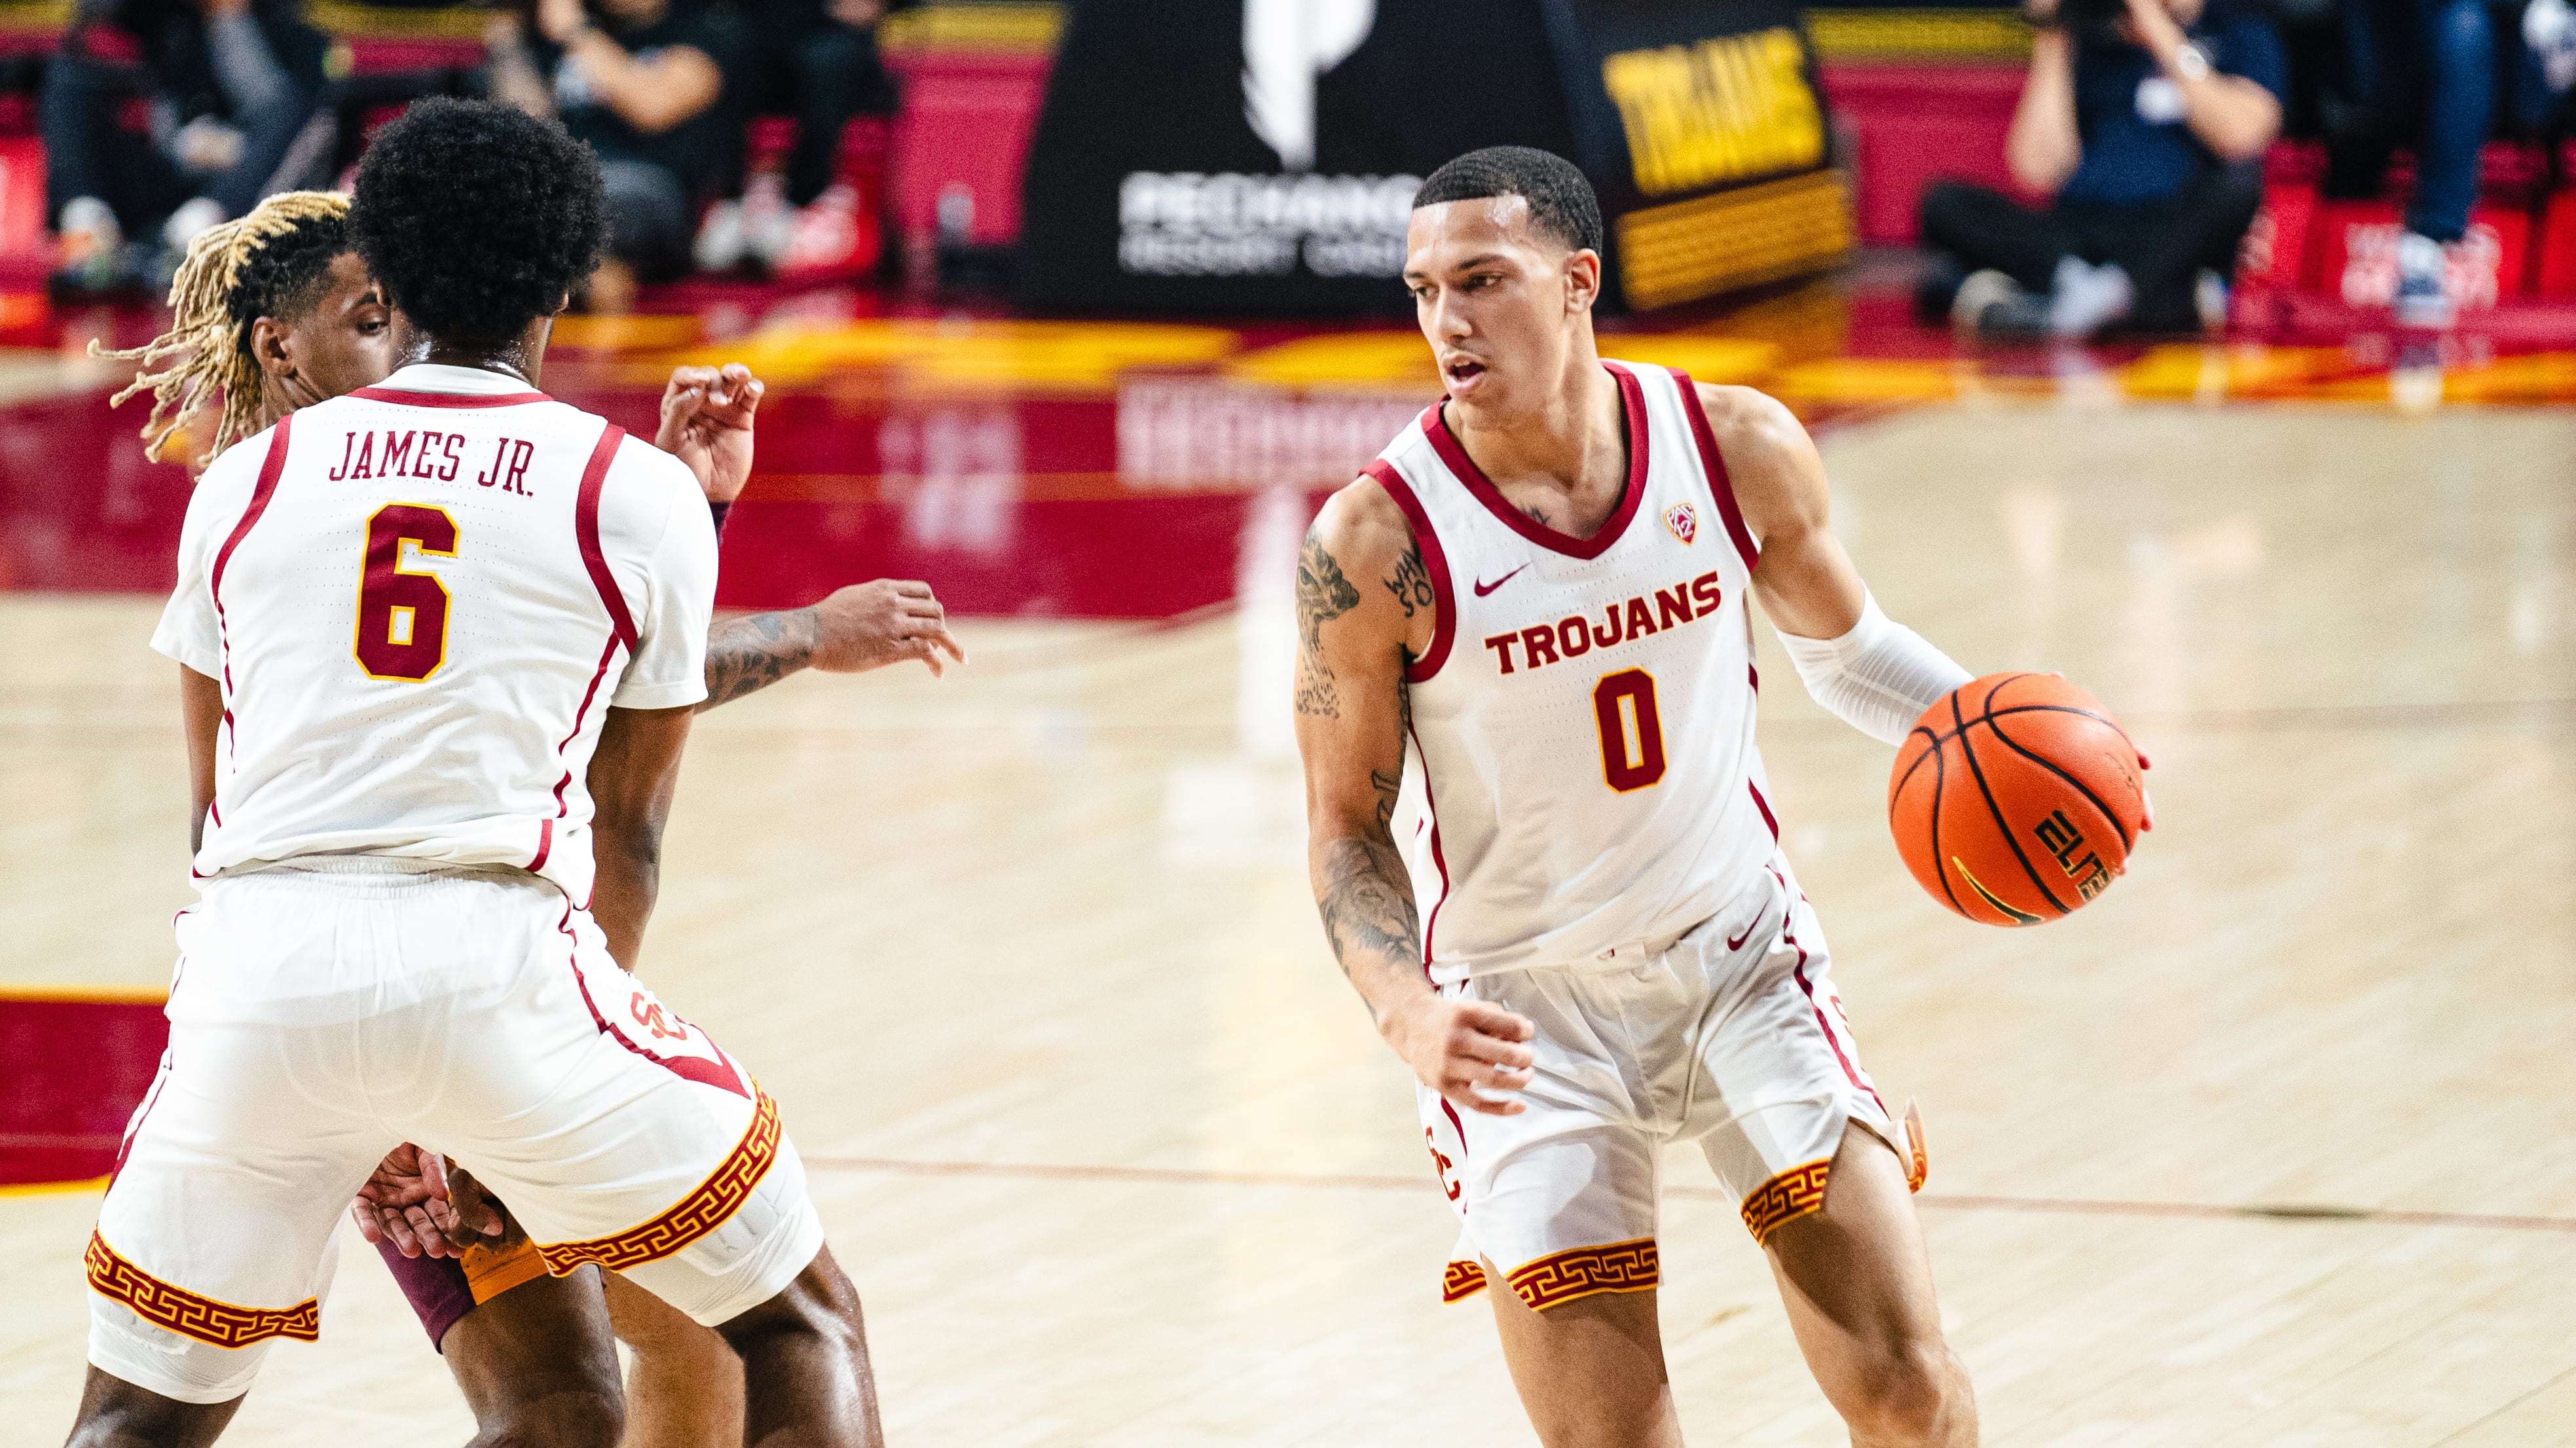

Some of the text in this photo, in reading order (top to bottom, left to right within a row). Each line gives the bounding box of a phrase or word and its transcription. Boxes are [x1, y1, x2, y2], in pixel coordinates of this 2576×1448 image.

[329, 430, 534, 497] JAMES JR.
[352, 501, 461, 683] 6
[1484, 570, 1722, 675] TROJANS
[1591, 665, 1667, 794] 0
